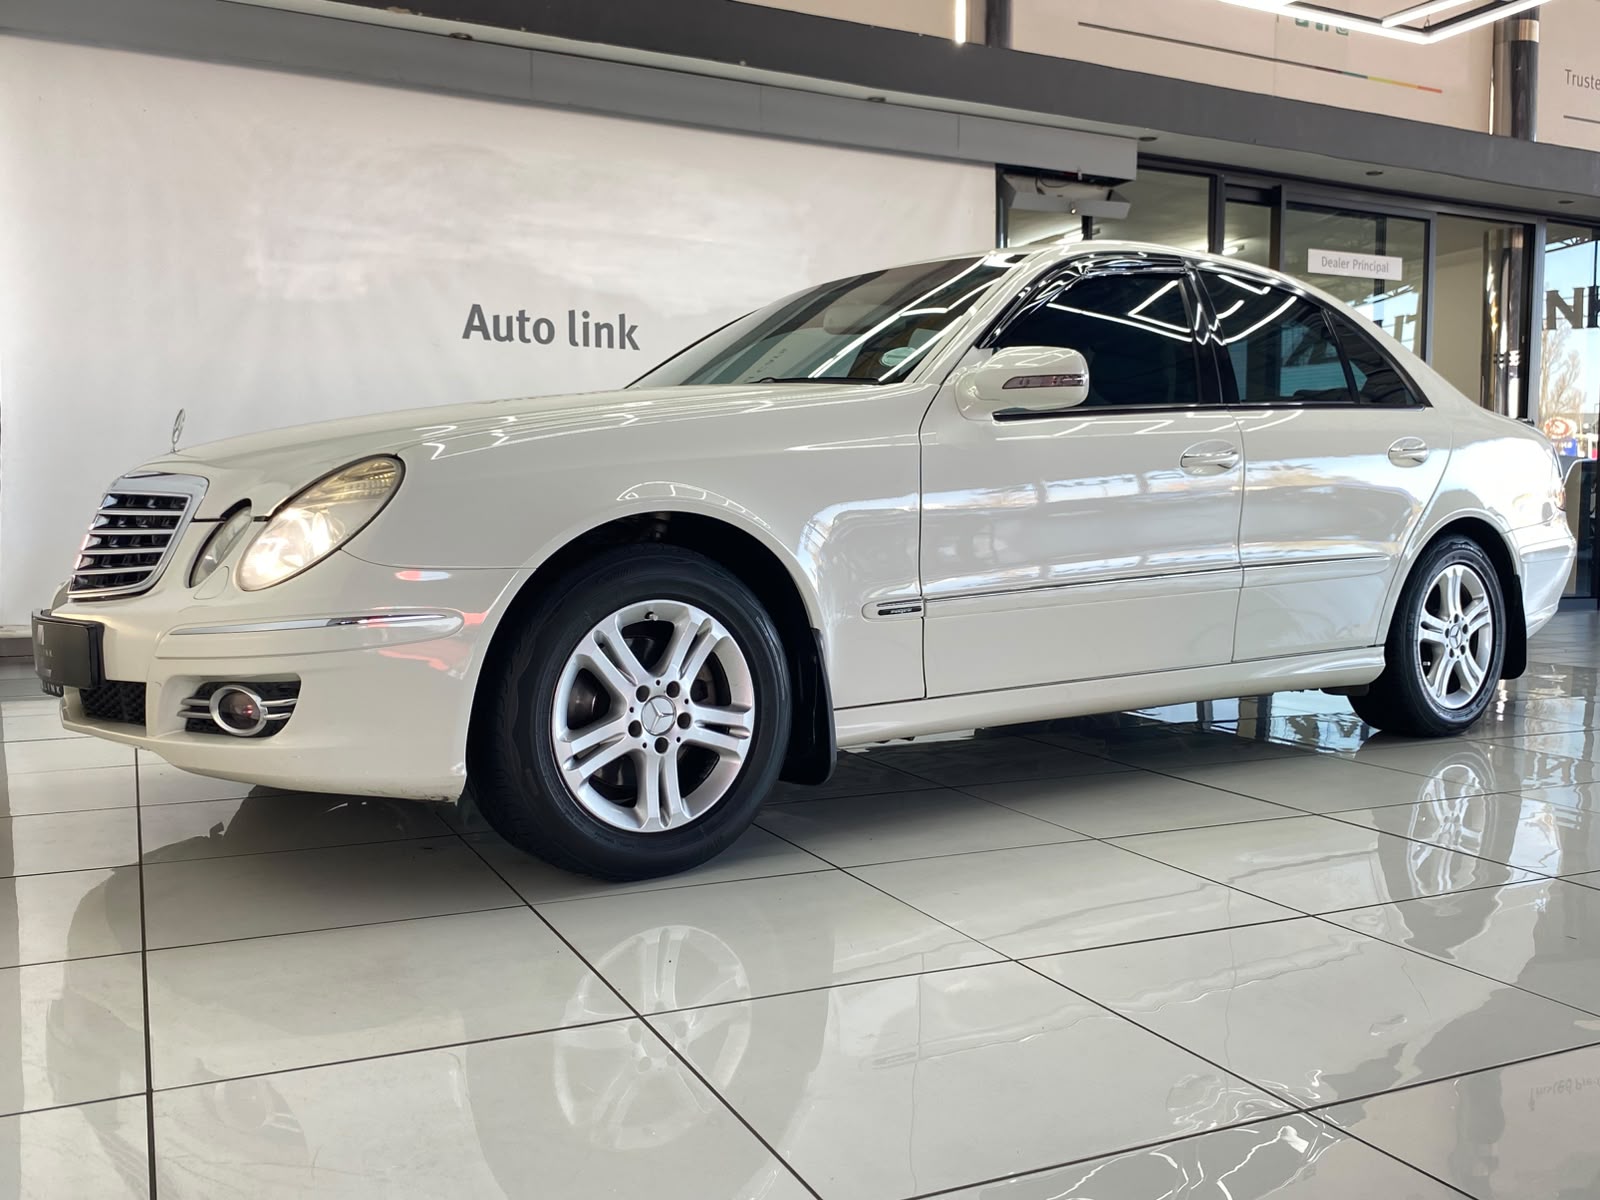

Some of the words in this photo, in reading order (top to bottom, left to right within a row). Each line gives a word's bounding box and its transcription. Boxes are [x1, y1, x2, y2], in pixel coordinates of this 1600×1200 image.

[1321, 256, 1350, 269] Dealer
[1352, 259, 1389, 274] Principal
[461, 303, 555, 345] Auto
[568, 309, 641, 351] link
